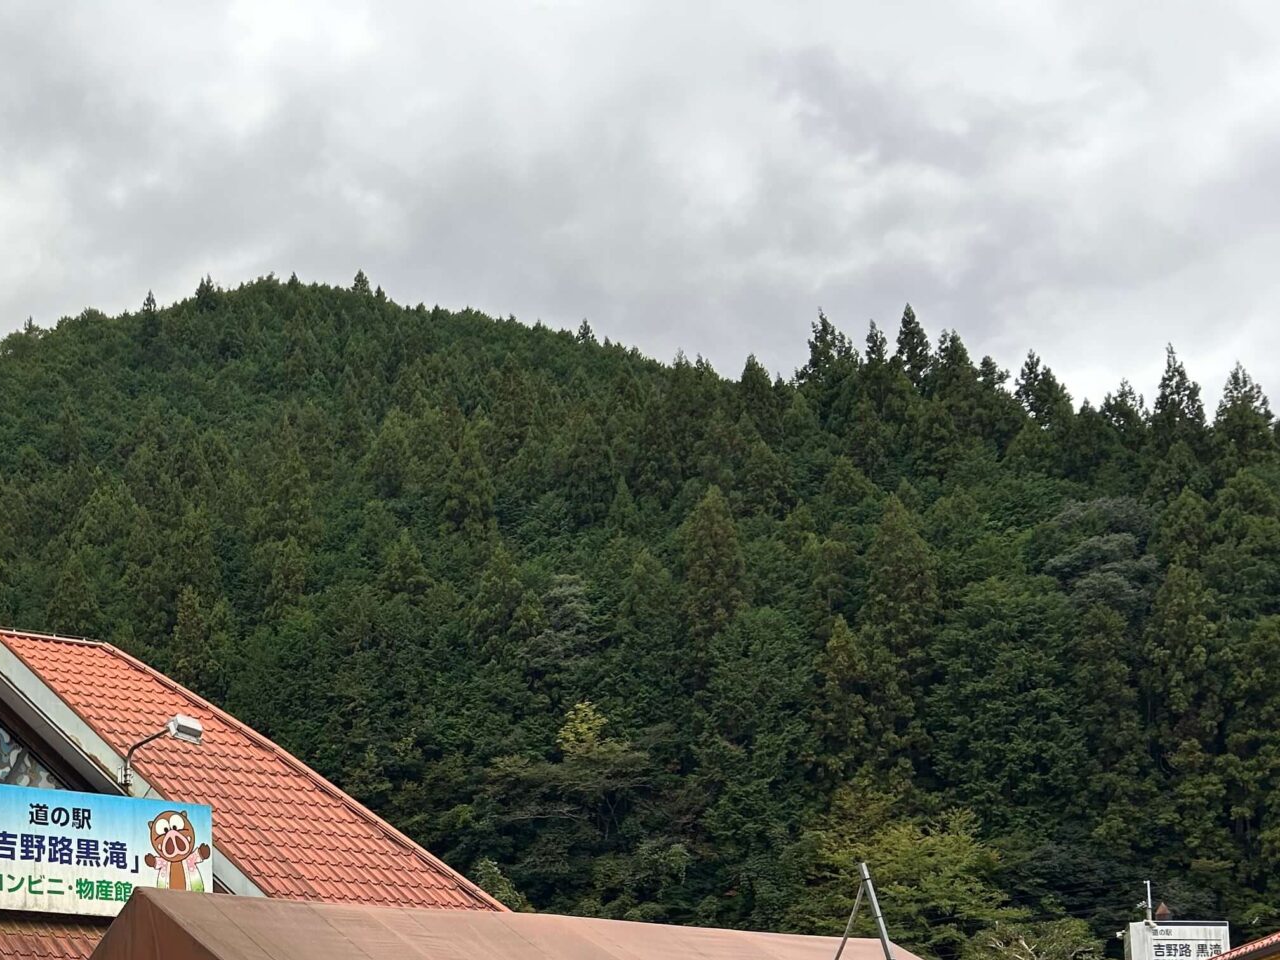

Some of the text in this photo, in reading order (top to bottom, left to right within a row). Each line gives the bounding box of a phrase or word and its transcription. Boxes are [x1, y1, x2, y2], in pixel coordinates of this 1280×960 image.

[29, 803, 91, 830] 道の駅
[1152, 928, 1172, 936] 道の駅
[1153, 943, 1192, 958] 吉野路
